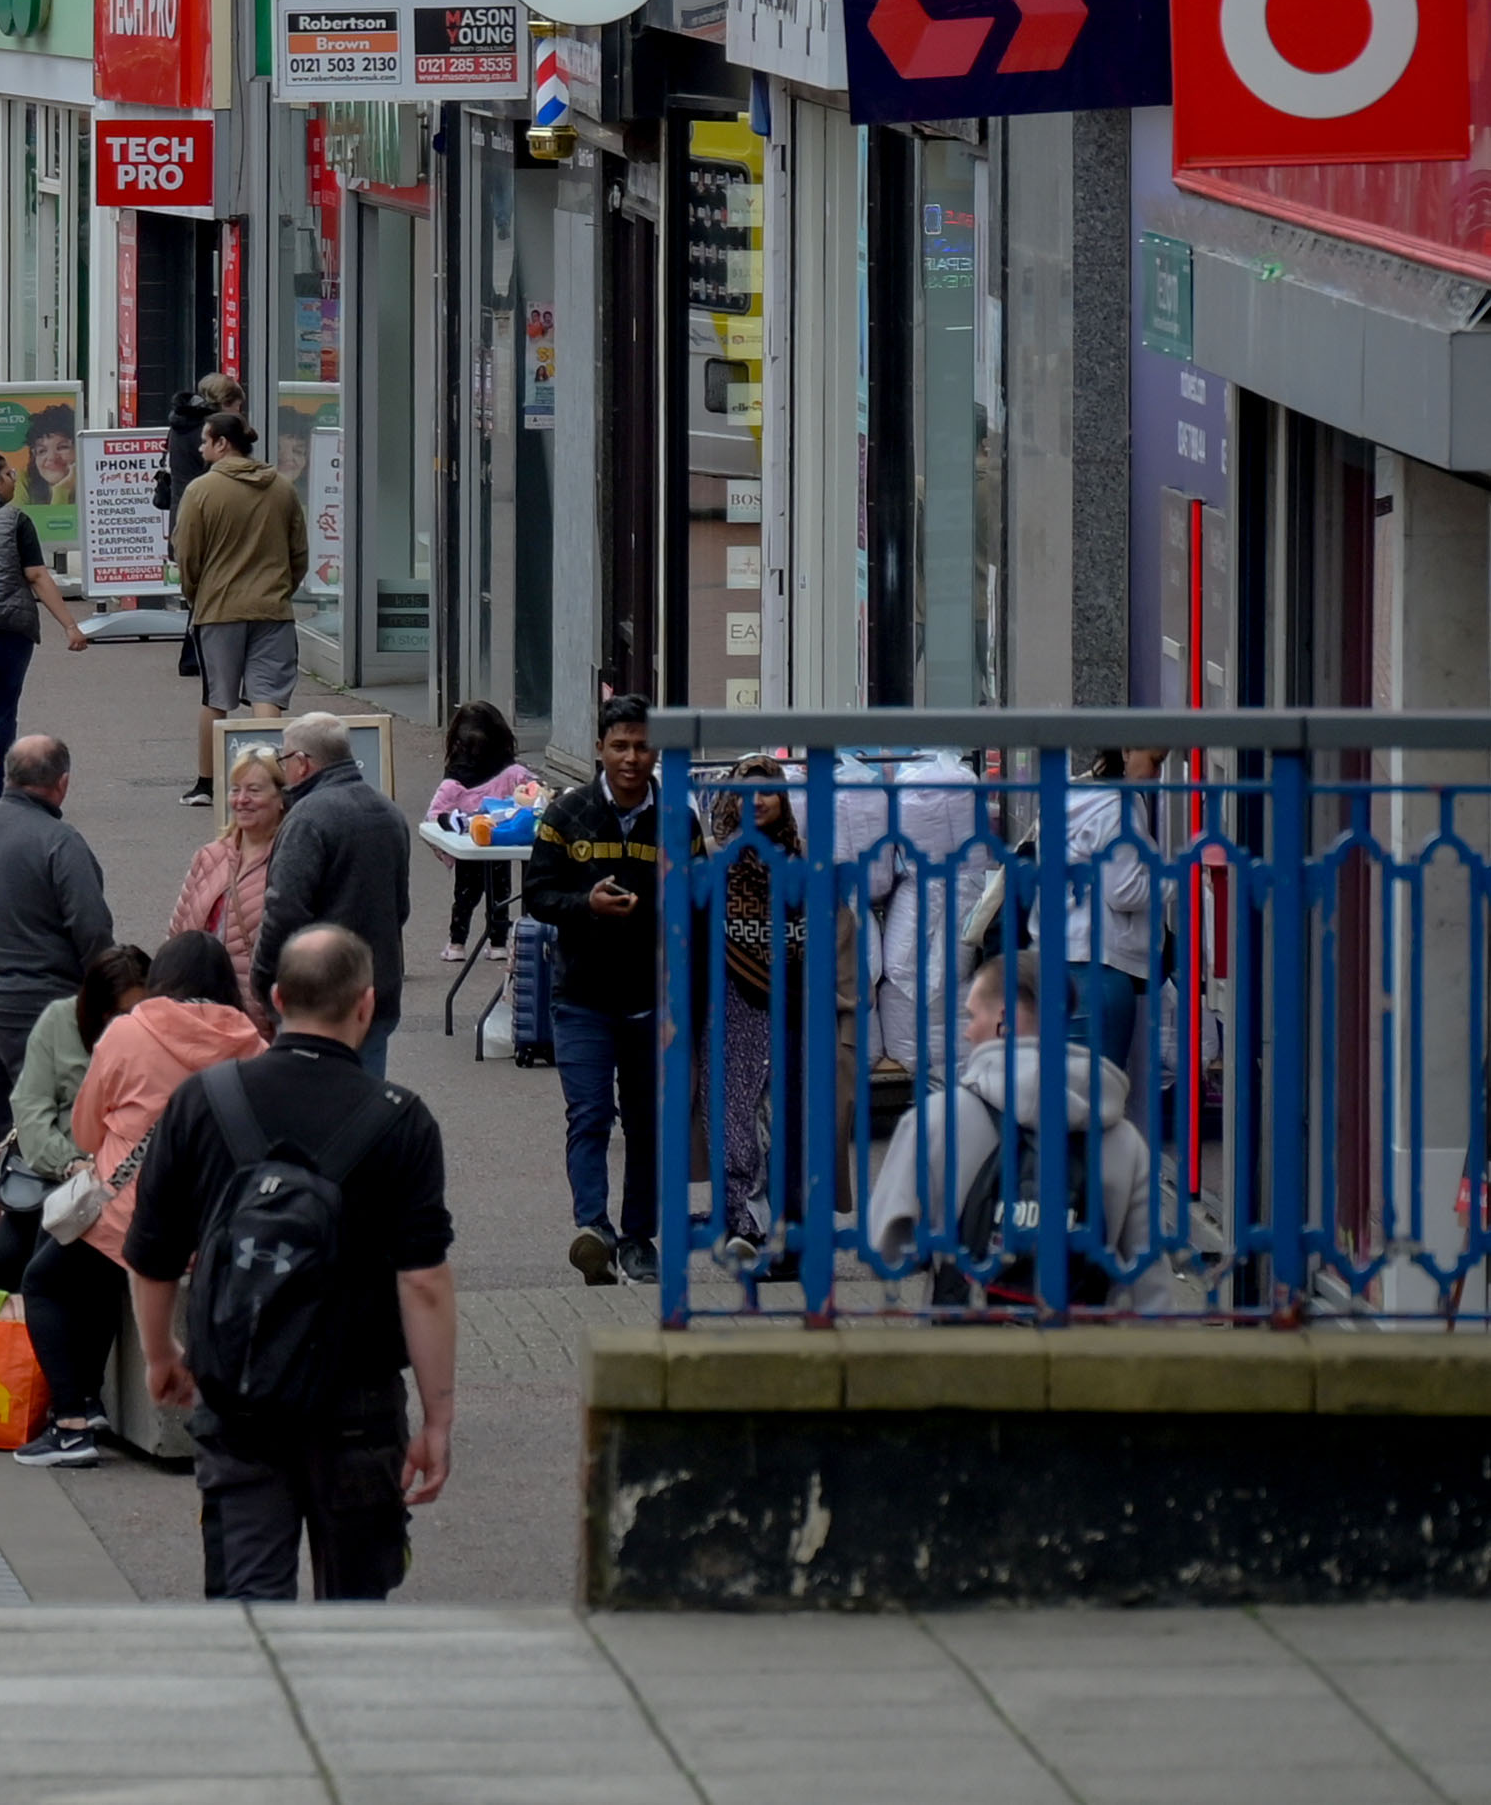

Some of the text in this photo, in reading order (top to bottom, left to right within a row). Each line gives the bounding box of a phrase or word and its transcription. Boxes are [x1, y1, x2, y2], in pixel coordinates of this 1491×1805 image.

[298, 16, 386, 30] Robertson
[445, 9, 514, 26] MASON
[447, 27, 514, 44] YOUNG
[316, 37, 370, 50] Brown
[290, 57, 397, 73] 0121 503 2130
[418, 57, 512, 72] 0121 285 3535
[106, 137, 194, 163] TECH
[117, 164, 184, 190] PRO
[9, 415, 25, 424] £70
[107, 442, 139, 453] TECH
[95, 459, 147, 471] iPHONE
[120, 487, 142, 495] SELL
[96, 498, 150, 506] UNLOCKING
[97, 507, 136, 515] REPAIRS
[98, 516, 161, 525] ACCESSORIES
[98, 526, 147, 535] BATTERIES
[98, 536, 154, 545] EARPHONES
[99, 546, 153, 555] BLUETOOTH
[395, 595, 422, 606] kids
